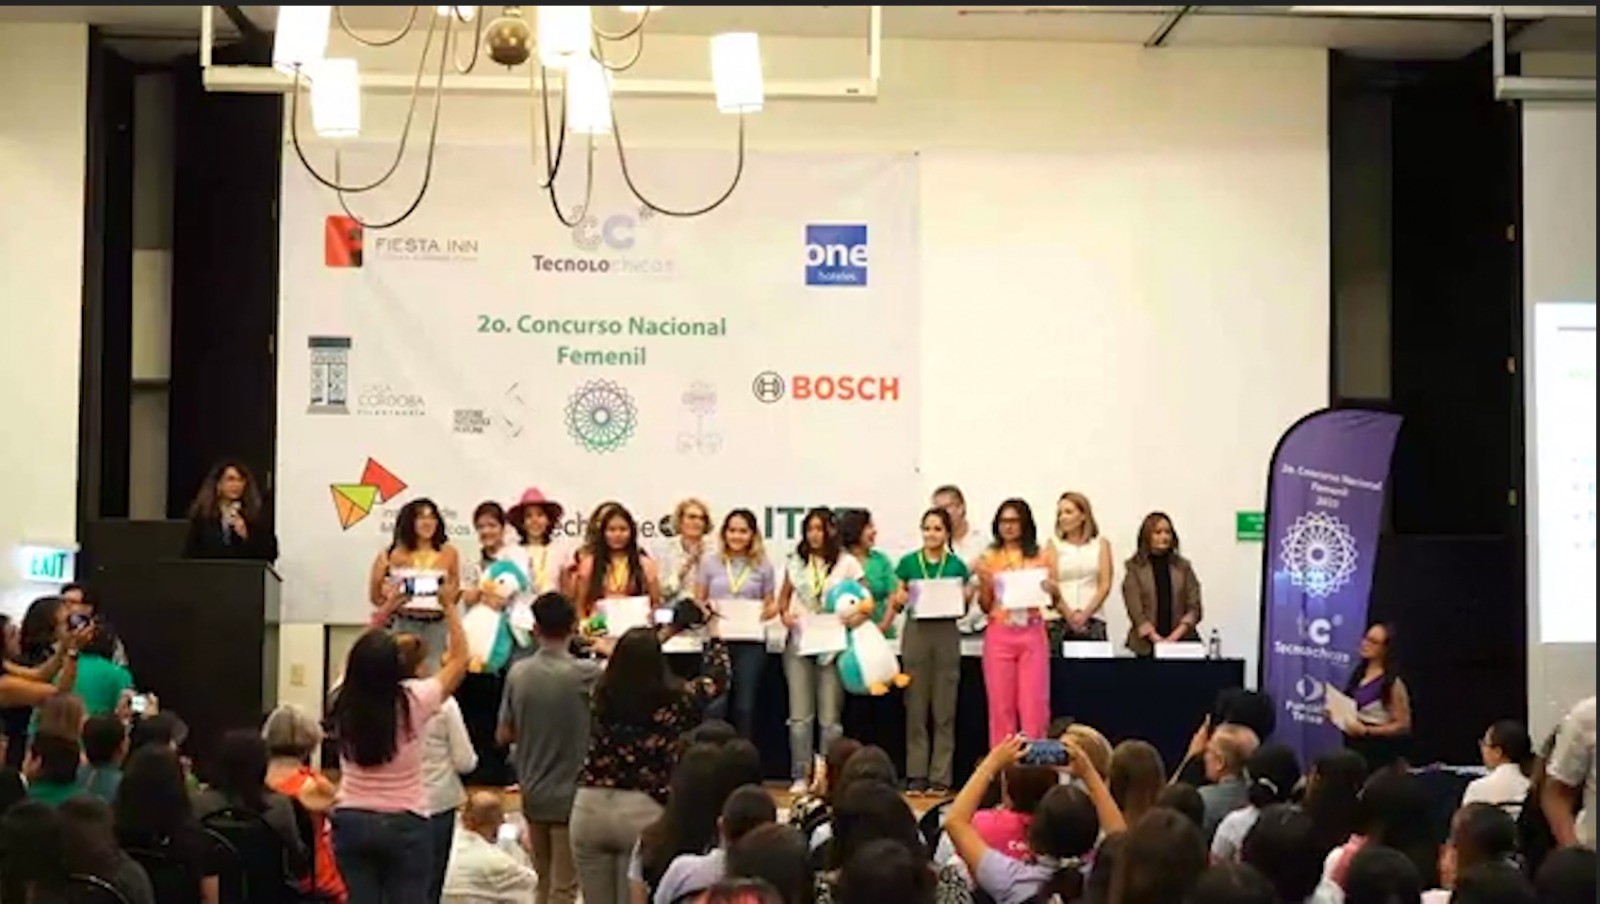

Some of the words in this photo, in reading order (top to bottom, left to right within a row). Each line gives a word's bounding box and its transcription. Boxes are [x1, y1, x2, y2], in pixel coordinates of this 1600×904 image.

[376, 238, 440, 253] FIESTA
[447, 239, 478, 253] INN
[805, 243, 868, 267] one
[477, 315, 511, 334] 2o.
[517, 315, 622, 336] Concurso
[629, 317, 726, 337] Nacional
[557, 346, 647, 366] Femenil
[791, 376, 899, 401] BOSCH
